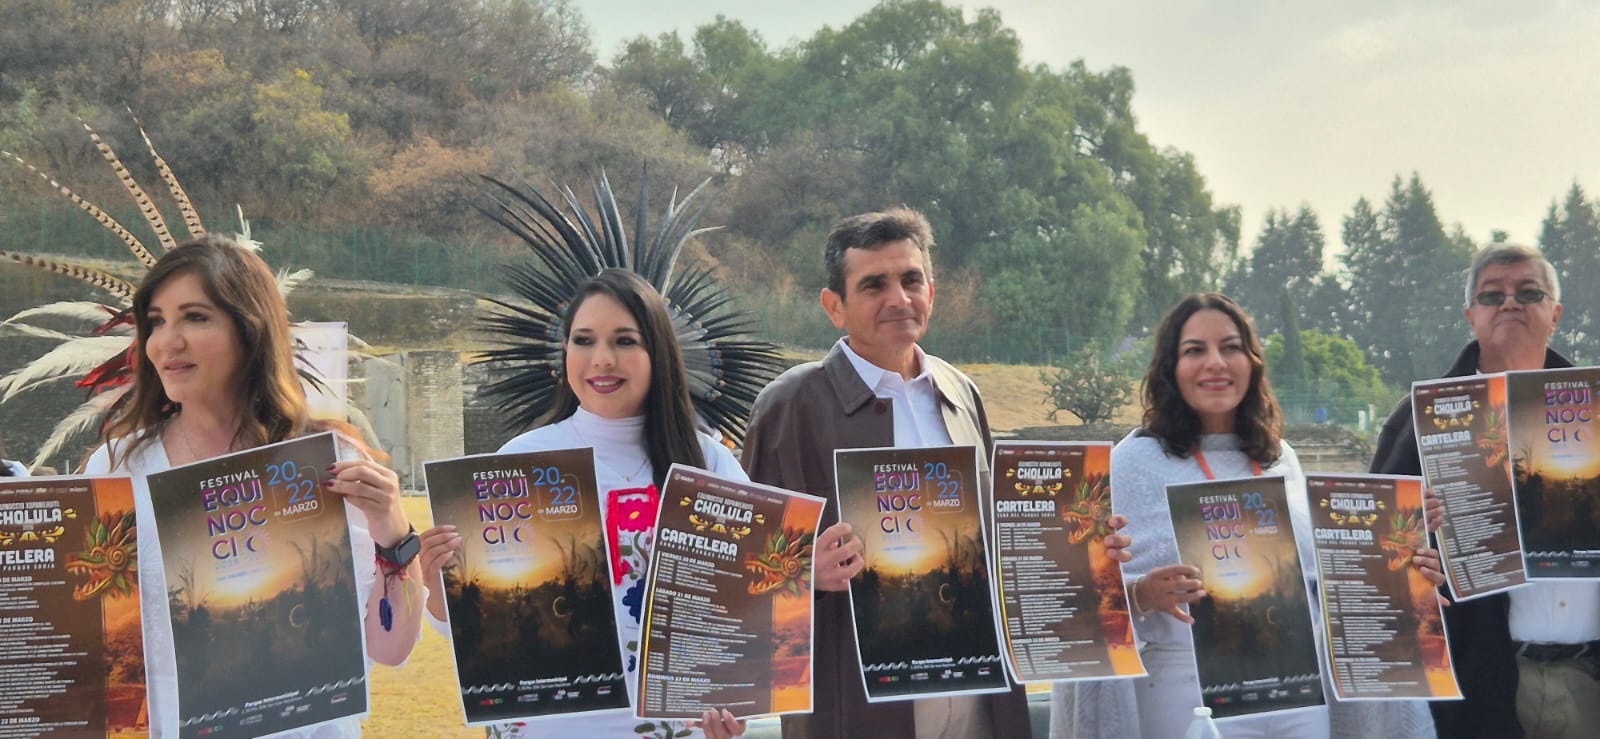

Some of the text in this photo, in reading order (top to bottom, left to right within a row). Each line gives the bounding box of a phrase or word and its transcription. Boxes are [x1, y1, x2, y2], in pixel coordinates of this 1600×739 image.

[1544, 382, 1590, 390] FESTIVAL
[1545, 389, 1591, 406] EQUI
[1434, 401, 1472, 414] CHOLULA
[1546, 408, 1592, 424] NOC
[1421, 430, 1470, 446] CARTELERA
[473, 469, 526, 480] FESTIVAL
[874, 464, 918, 472] FESTIVAL
[1018, 468, 1062, 480] CHOLULA
[200, 469, 259, 490] FESTIVAL
[874, 472, 920, 492] EQUI
[202, 479, 264, 512] EQUI
[286, 479, 316, 504] 22
[474, 478, 529, 501] EQUI
[549, 486, 576, 505] 22
[937, 480, 960, 499] 22
[877, 494, 922, 513] NOC
[933, 498, 960, 508] MARZO
[996, 500, 1055, 512] CARTELERA
[1200, 494, 1238, 504] FESTIVAL
[1330, 499, 1376, 510] CHOLULA
[0, 508, 62, 525] HOLULA
[282, 500, 318, 516] MARZO
[479, 501, 532, 522] NOC
[546, 505, 578, 514] MARZO
[694, 500, 752, 524] CHOLULA
[1200, 502, 1240, 523] EQUI
[208, 504, 268, 538] NOC
[1256, 508, 1276, 526] 22
[1206, 522, 1247, 542] NOC
[1314, 528, 1372, 540] CARTELERA
[661, 528, 738, 556] CARTELERA
[0, 548, 54, 564] TELERA
